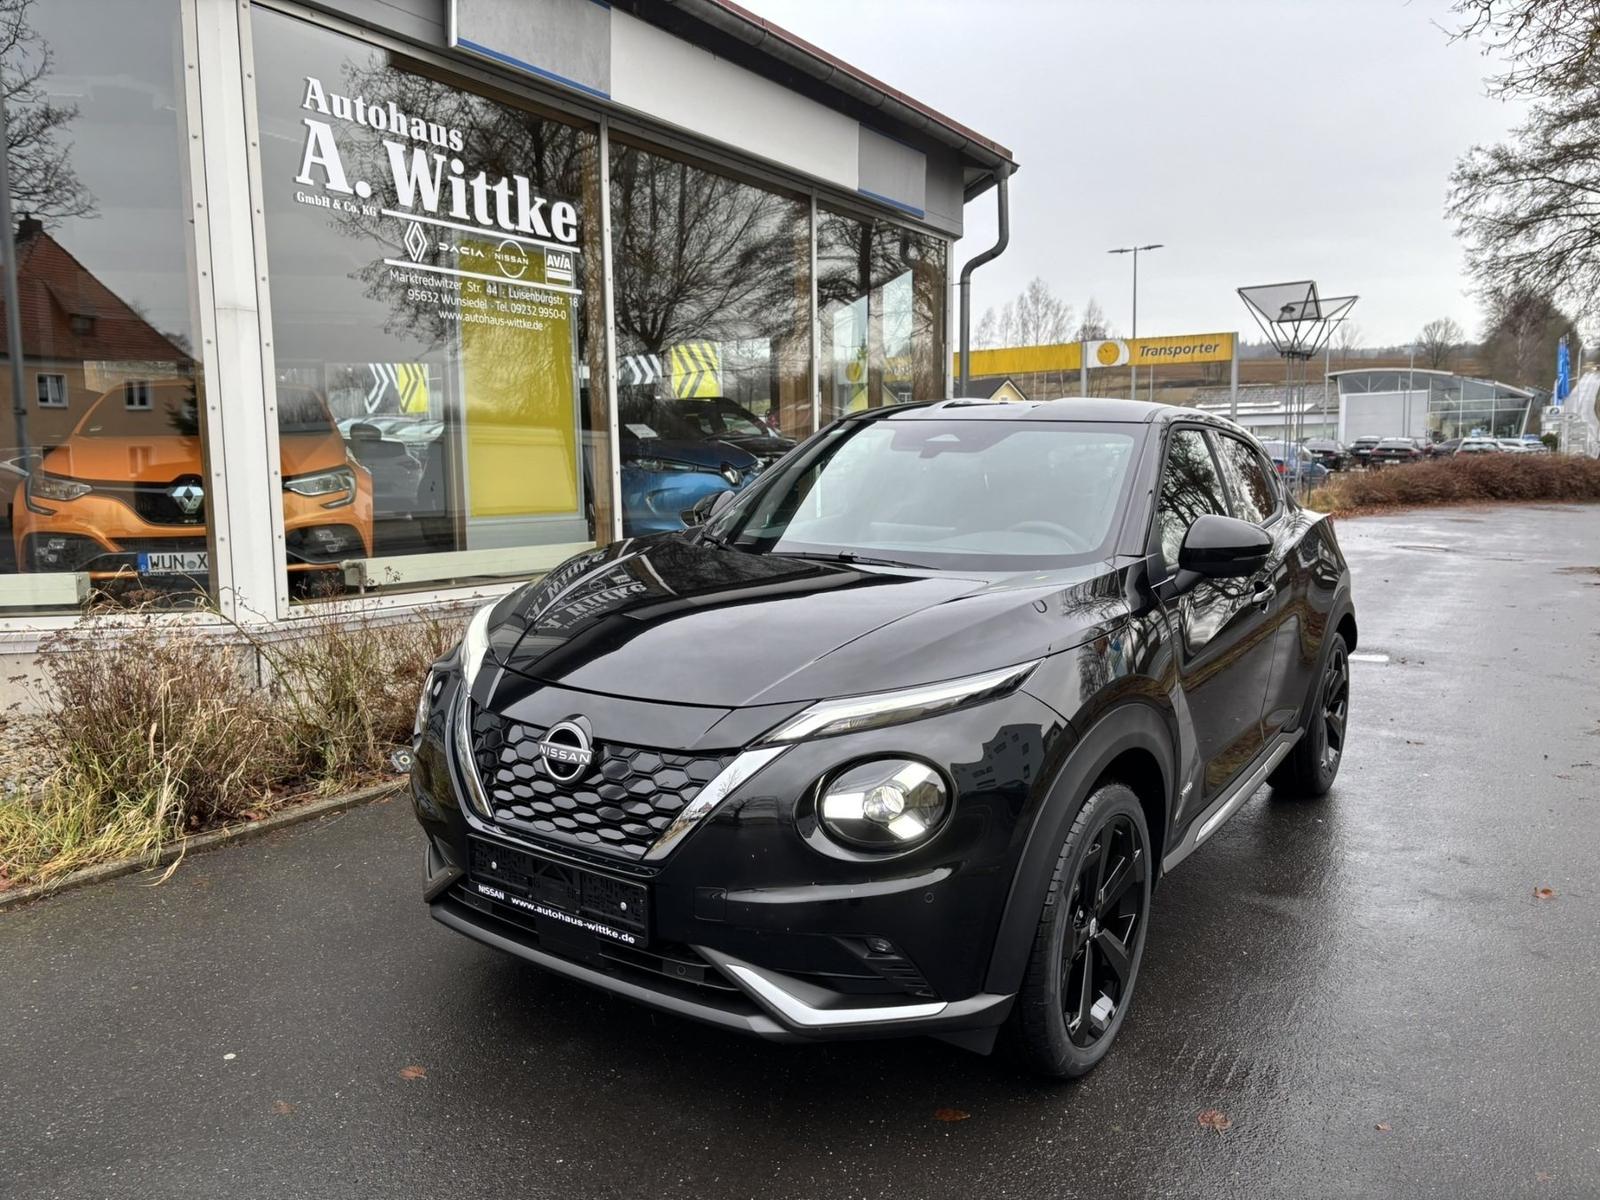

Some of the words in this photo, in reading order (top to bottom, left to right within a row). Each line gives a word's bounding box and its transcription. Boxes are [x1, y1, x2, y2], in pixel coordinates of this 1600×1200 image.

[303, 76, 463, 152] Autohaus
[296, 118, 371, 198] A.
[383, 139, 577, 242] Wittke
[297, 191, 331, 208] GmbH
[333, 199, 341, 210] &
[344, 201, 359, 214] Co.
[362, 204, 376, 217] KG
[439, 242, 485, 258] DACIA
[494, 252, 529, 265] NISSAN
[390, 270, 463, 290] Marktredwitzer
[467, 281, 482, 293] Str.
[508, 287, 565, 306] Luisenburgstr.
[407, 289, 439, 303] 95632
[440, 293, 487, 309] Wunsiedel
[496, 301, 509, 312] Tel.
[510, 303, 537, 316] 09232
[538, 307, 567, 320] 9950-0
[439, 310, 544, 331] www.autohaus-wittke.de
[1139, 342, 1220, 358] Transporter
[149, 554, 185, 569] WUN
[540, 744, 590, 763] NISSAN
[478, 884, 505, 900] NISSAN
[511, 897, 635, 944] www.autohaus-wittke.de
